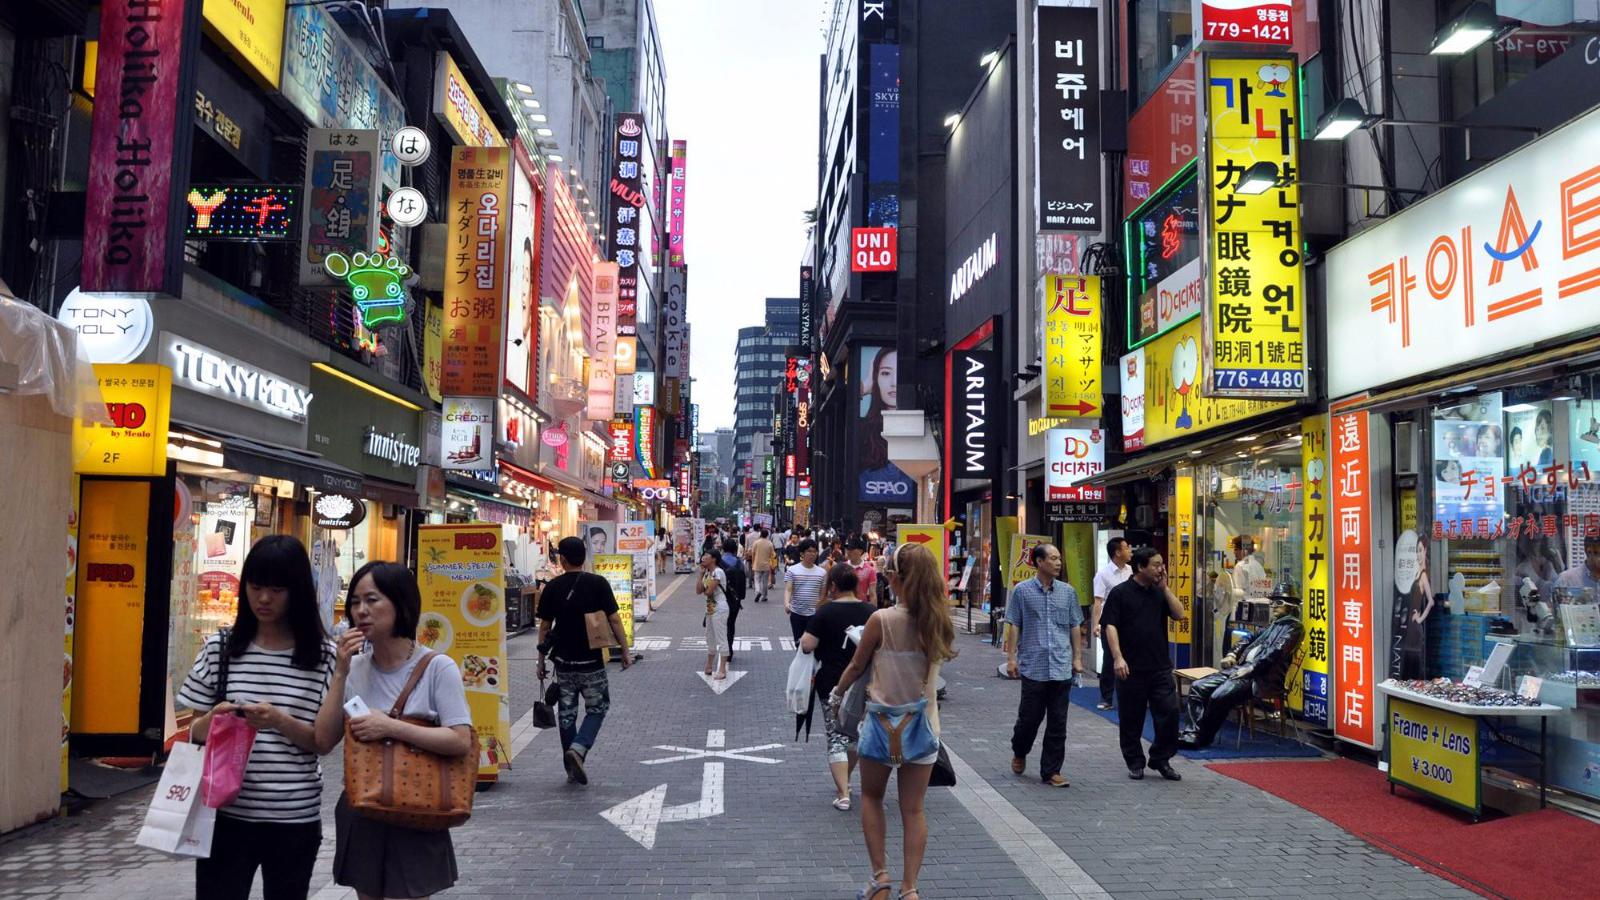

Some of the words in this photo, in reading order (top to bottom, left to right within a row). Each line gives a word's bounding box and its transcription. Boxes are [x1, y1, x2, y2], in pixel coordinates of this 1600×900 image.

[1256, 10, 1289, 22] 명동점
[1207, 22, 1290, 40] 779-1421
[120, 0, 163, 119] Holika
[1055, 40, 1087, 160] 비쥬헤어
[195, 90, 213, 124] 국수
[214, 112, 241, 150] 전문점
[329, 133, 360, 147] はな
[619, 140, 638, 179] 明洞
[103, 135, 153, 266] Holika
[610, 178, 646, 209] MUD
[1047, 201, 1094, 211] ビジュヘア
[1046, 216, 1066, 225] HAIR
[1072, 216, 1096, 225] SALON
[477, 192, 499, 290] 오다리집
[857, 234, 888, 249] UNI
[857, 251, 892, 268] QLO
[950, 233, 997, 305] ARITAUM
[1049, 277, 1093, 317] 足
[68, 309, 134, 318] TONY
[450, 297, 496, 320] お粥
[668, 284, 681, 367] Cookie
[802, 303, 810, 346] SKYPARK
[1216, 341, 1302, 364] 明洞1號店
[1051, 334, 1065, 392] 마사지
[131, 378, 154, 387] 전문점
[1215, 370, 1304, 388] 776-4480
[446, 414, 489, 422] CREDIT
[799, 402, 808, 428] SPAO
[966, 356, 985, 472] ARITAUM
[368, 425, 420, 467] innisfree
[1304, 429, 1325, 453] 가나
[103, 452, 121, 463] 2F
[1051, 461, 1102, 477] 디디치킨
[865, 480, 909, 496] SPAO
[1459, 458, 1591, 501] チョーやすい
[1077, 486, 1102, 501] 1만원
[318, 518, 350, 526] innisfree
[454, 532, 498, 551] PHO
[630, 527, 644, 537] 2F
[86, 563, 135, 582] PHO
[429, 562, 464, 571] SUMMER
[467, 561, 498, 571] SPECIAL
[1308, 506, 1327, 662] カナ眼鏡
[1393, 712, 1428, 742] Frame
[1431, 726, 1440, 743] +
[1442, 726, 1471, 756] Lens
[1412, 757, 1420, 772] ¥
[166, 784, 191, 802] SPAO
